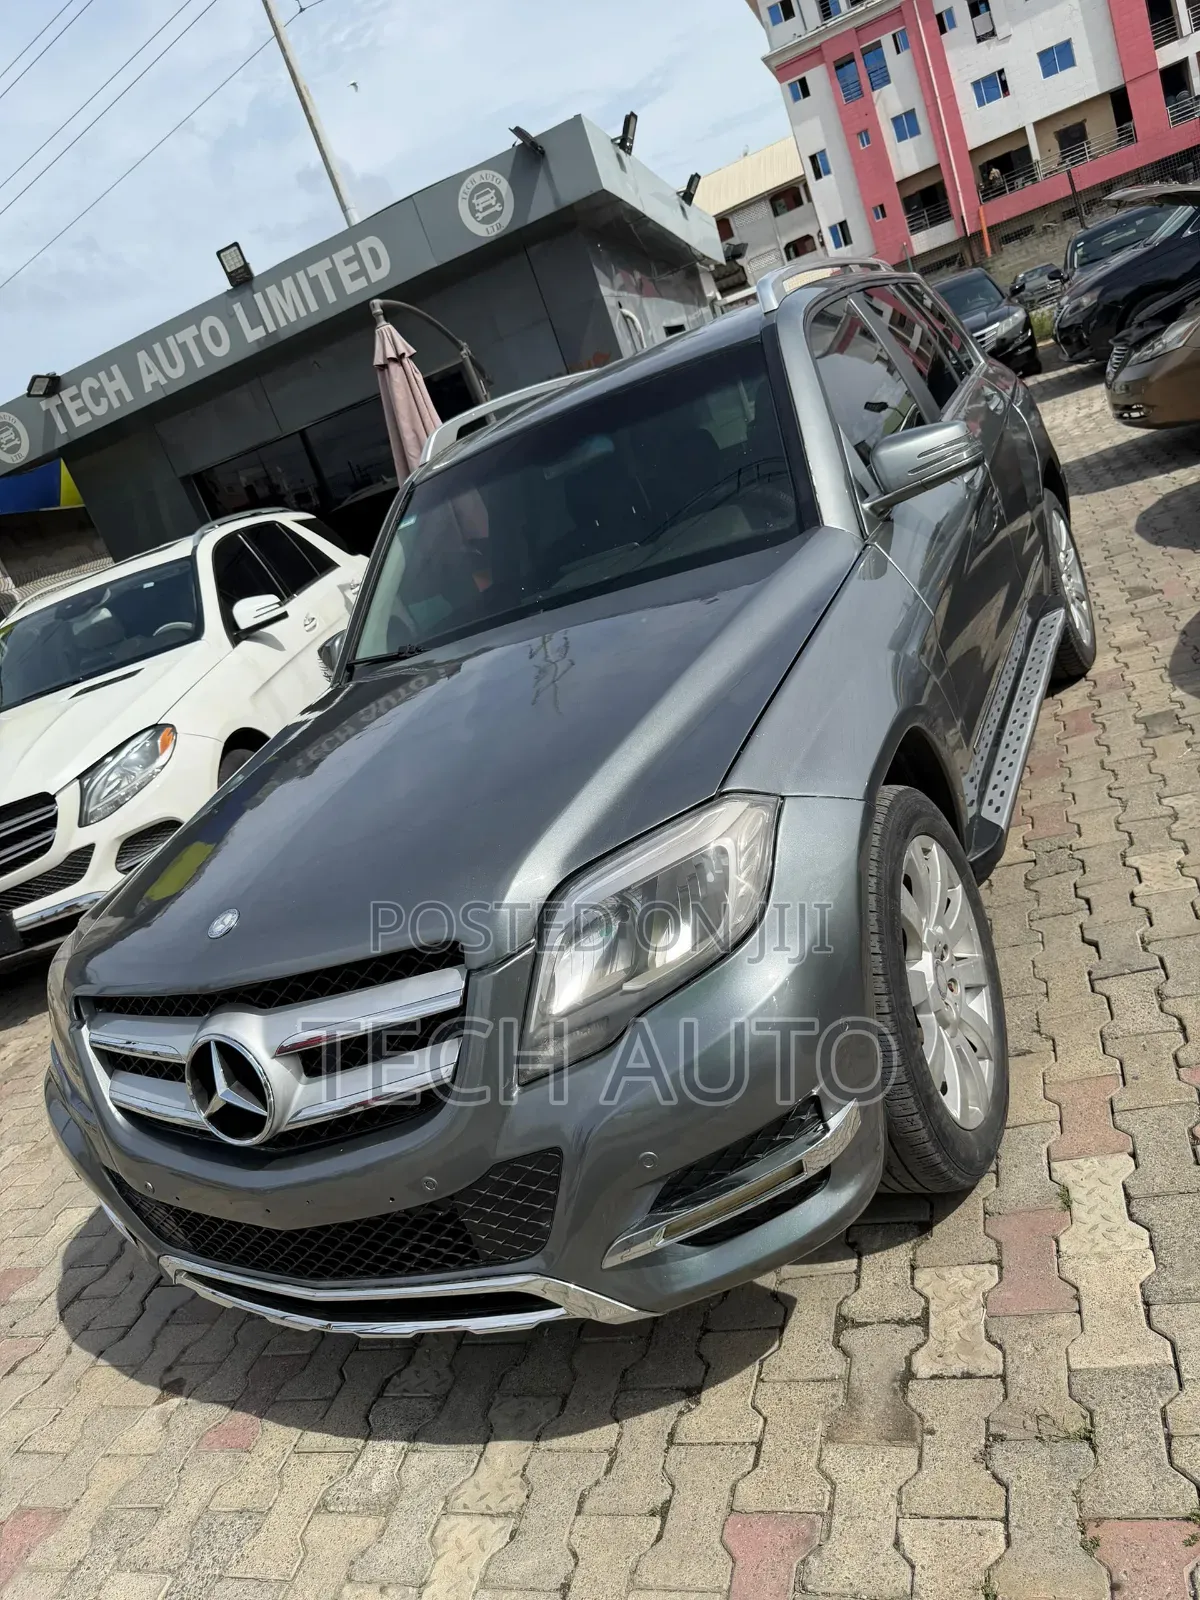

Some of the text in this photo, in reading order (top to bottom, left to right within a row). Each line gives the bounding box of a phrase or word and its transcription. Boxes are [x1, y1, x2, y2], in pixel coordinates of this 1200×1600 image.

[461, 172, 502, 201] TECH AUTO
[40, 235, 392, 435] TECH AUTO LIMITED
